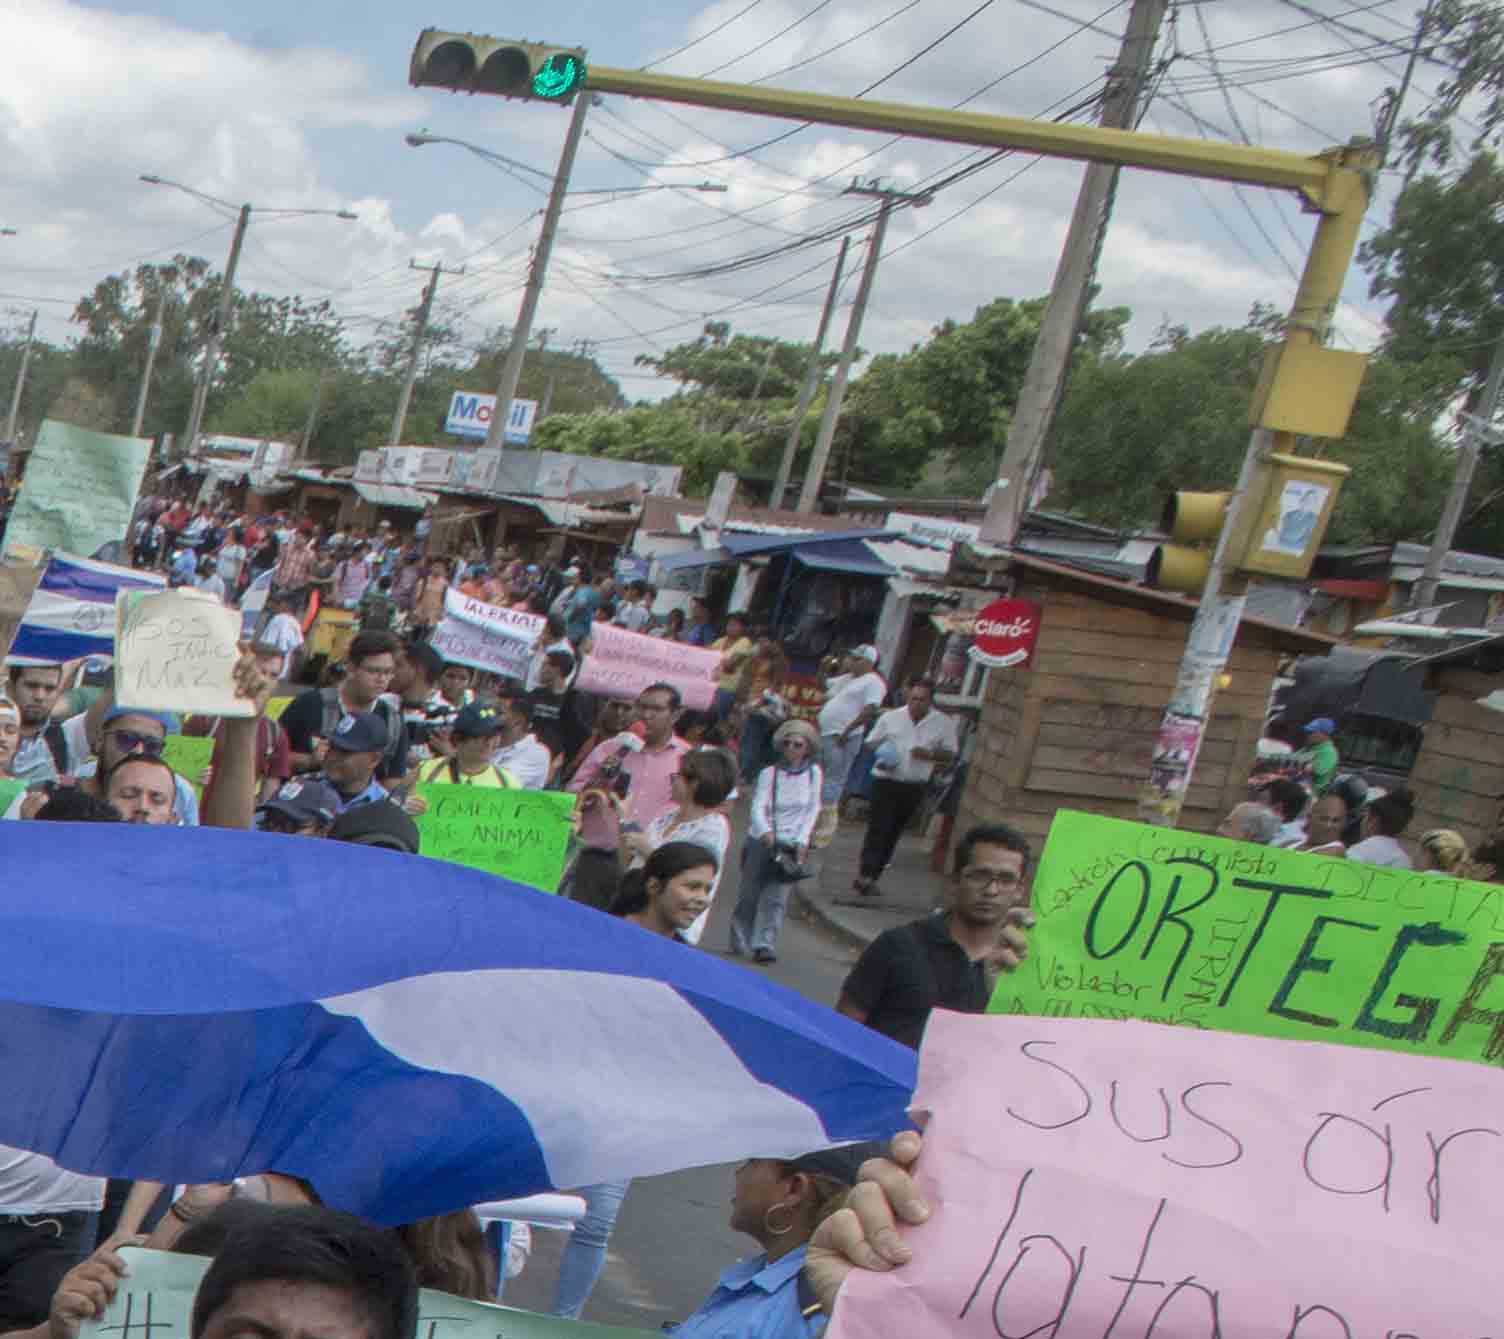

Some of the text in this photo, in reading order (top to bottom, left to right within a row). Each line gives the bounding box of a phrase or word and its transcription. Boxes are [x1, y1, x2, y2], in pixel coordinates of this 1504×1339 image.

[452, 396, 528, 426] Moil
[1314, 860, 1504, 932] DICTA
[1302, 1086, 1504, 1225] ár
